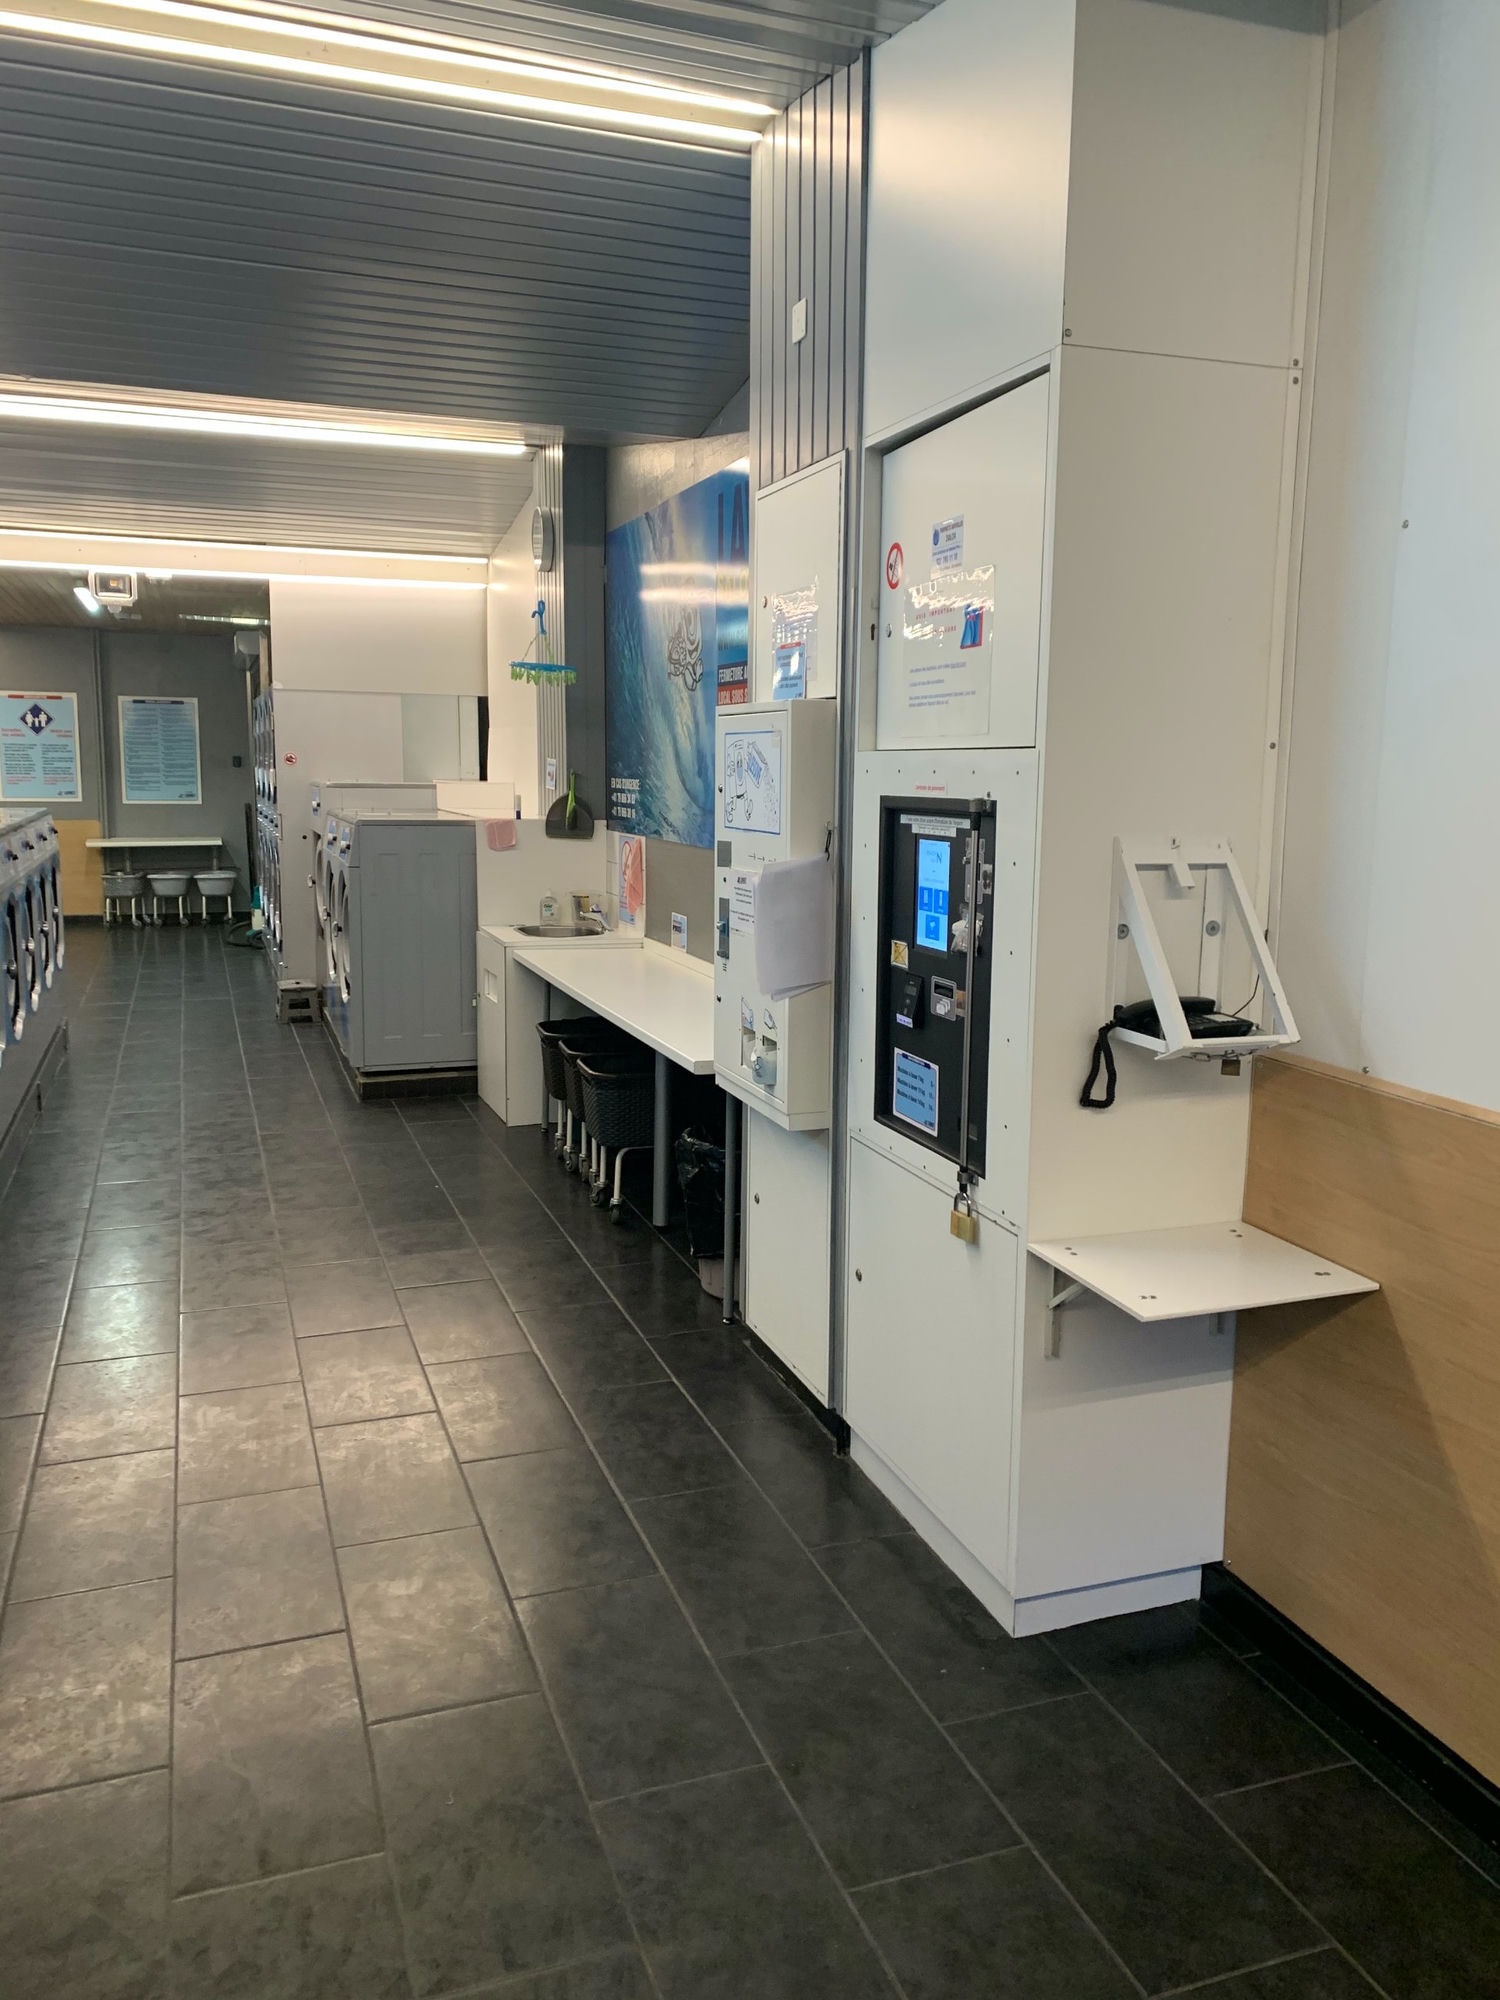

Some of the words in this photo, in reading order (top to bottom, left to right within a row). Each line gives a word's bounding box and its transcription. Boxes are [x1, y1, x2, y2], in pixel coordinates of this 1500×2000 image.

[718, 481, 749, 563] LA
[718, 666, 743, 683] FERMETURE
[718, 690, 731, 705] LOCAL
[731, 689, 744, 703] SOUS
